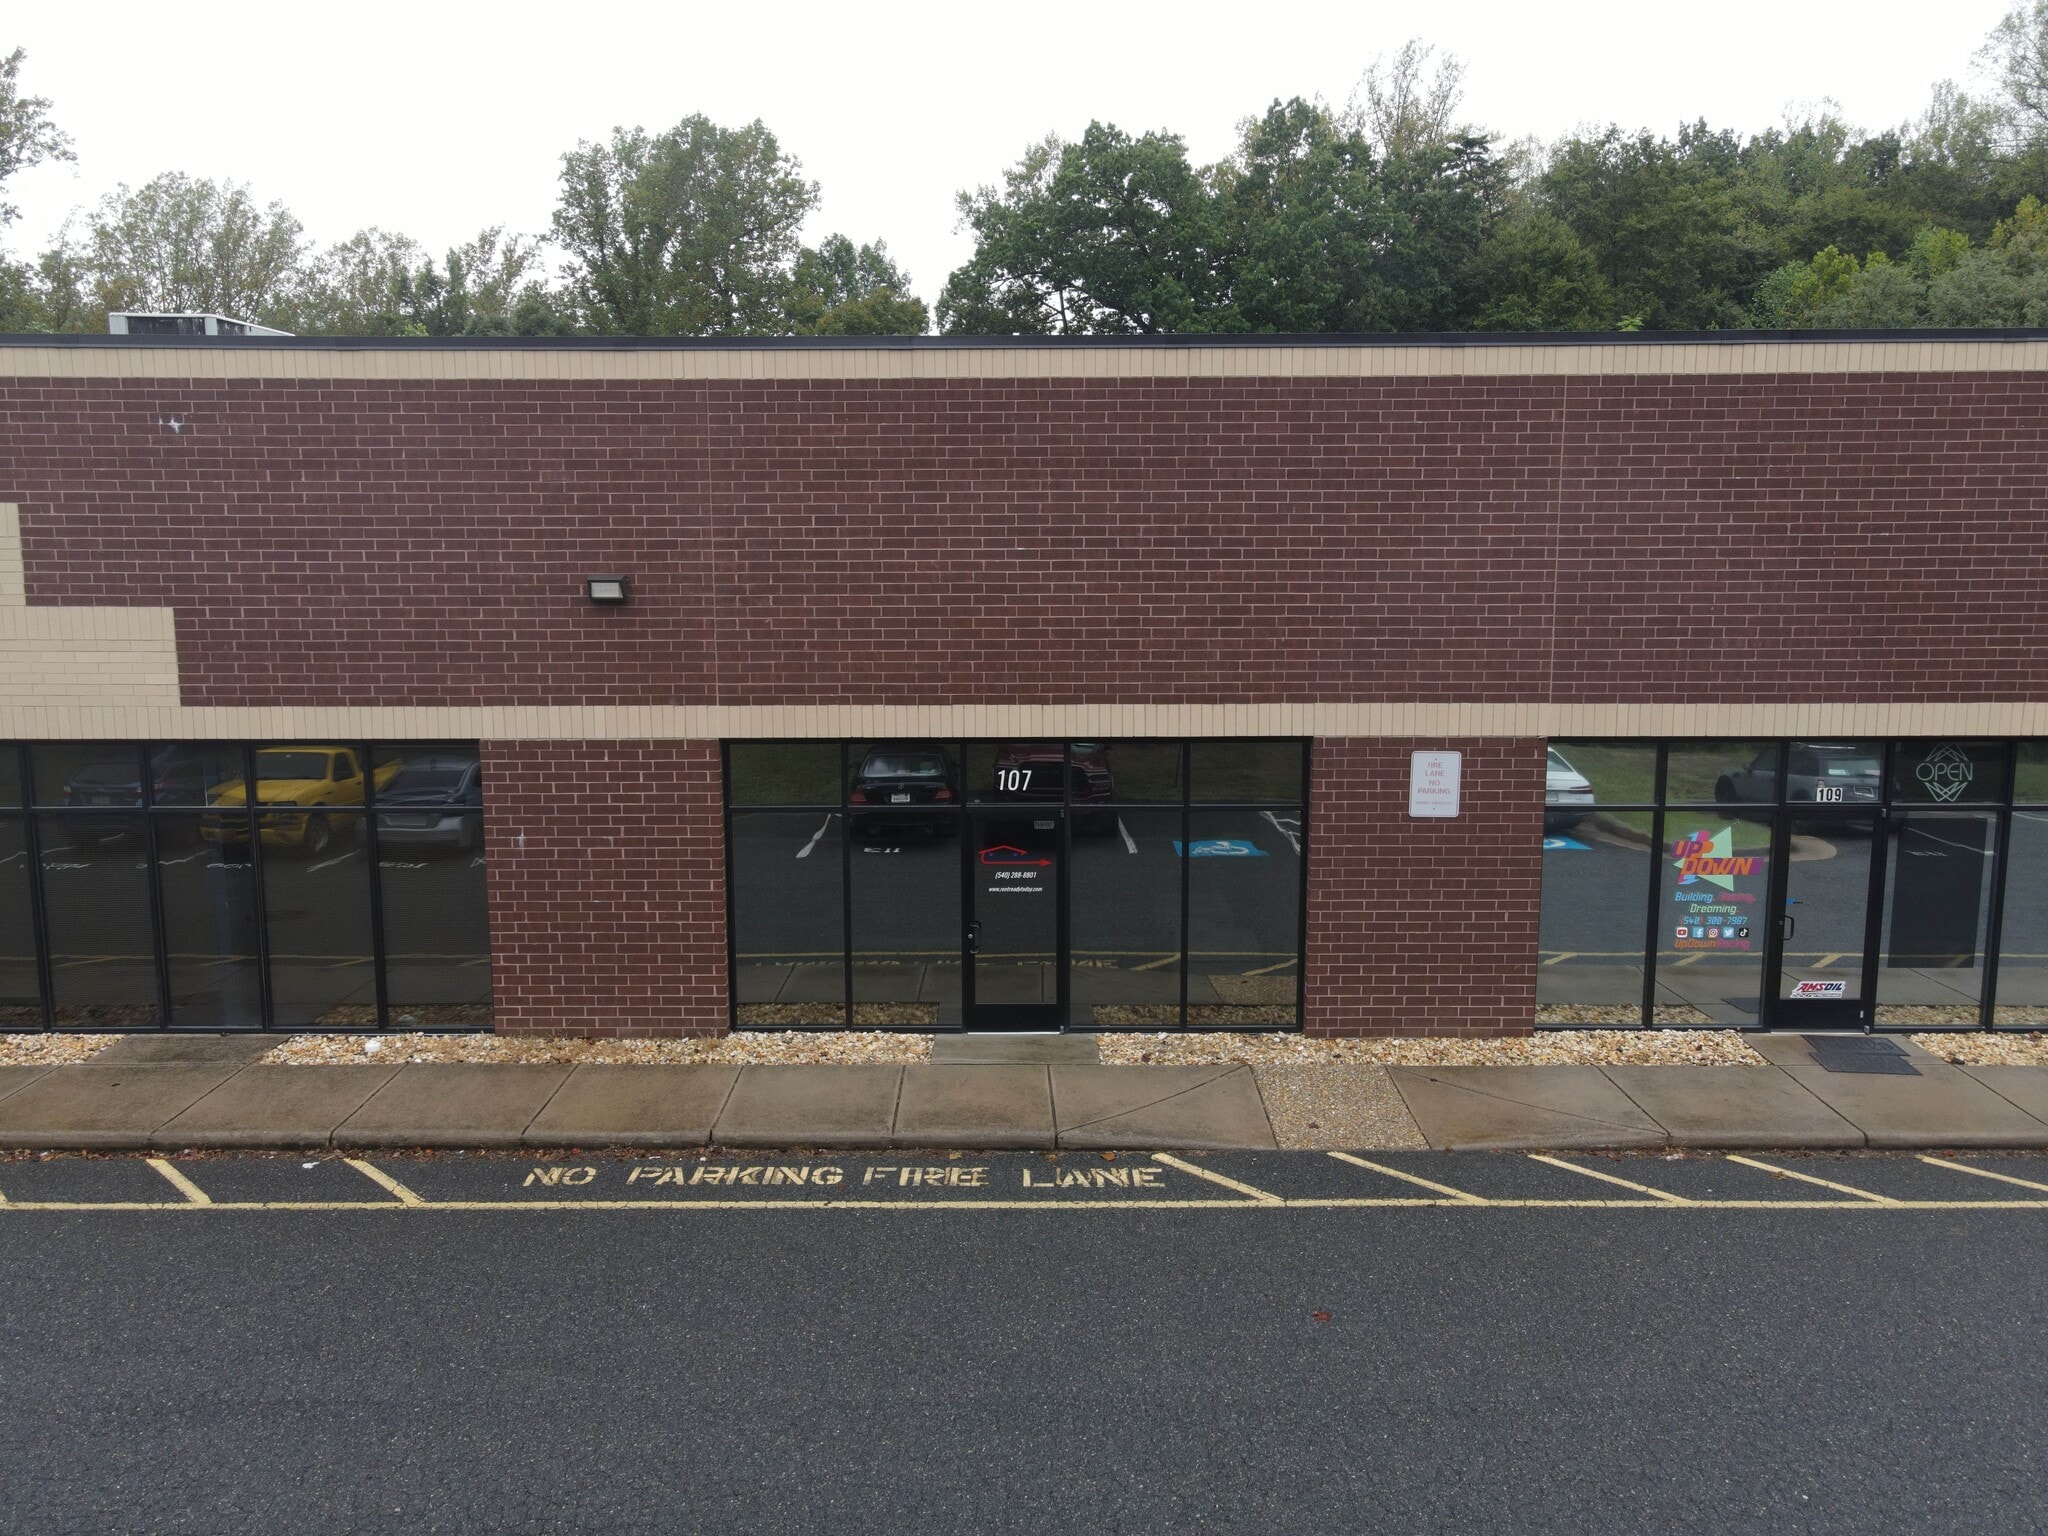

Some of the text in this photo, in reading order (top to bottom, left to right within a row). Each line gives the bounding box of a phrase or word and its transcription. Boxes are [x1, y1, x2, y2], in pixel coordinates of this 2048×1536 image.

[1916, 762, 1973, 781] OPEN
[998, 769, 1032, 791] 107
[1428, 779, 1441, 787] NO
[1417, 787, 1451, 795] PARKING
[1819, 788, 1842, 801] 109
[1680, 857, 1753, 875] DOWN
[1797, 983, 1842, 992] AMSOIL
[522, 1166, 598, 1187] NO
[625, 1165, 845, 1186] PARKING
[1022, 1167, 1166, 1188] LANE
